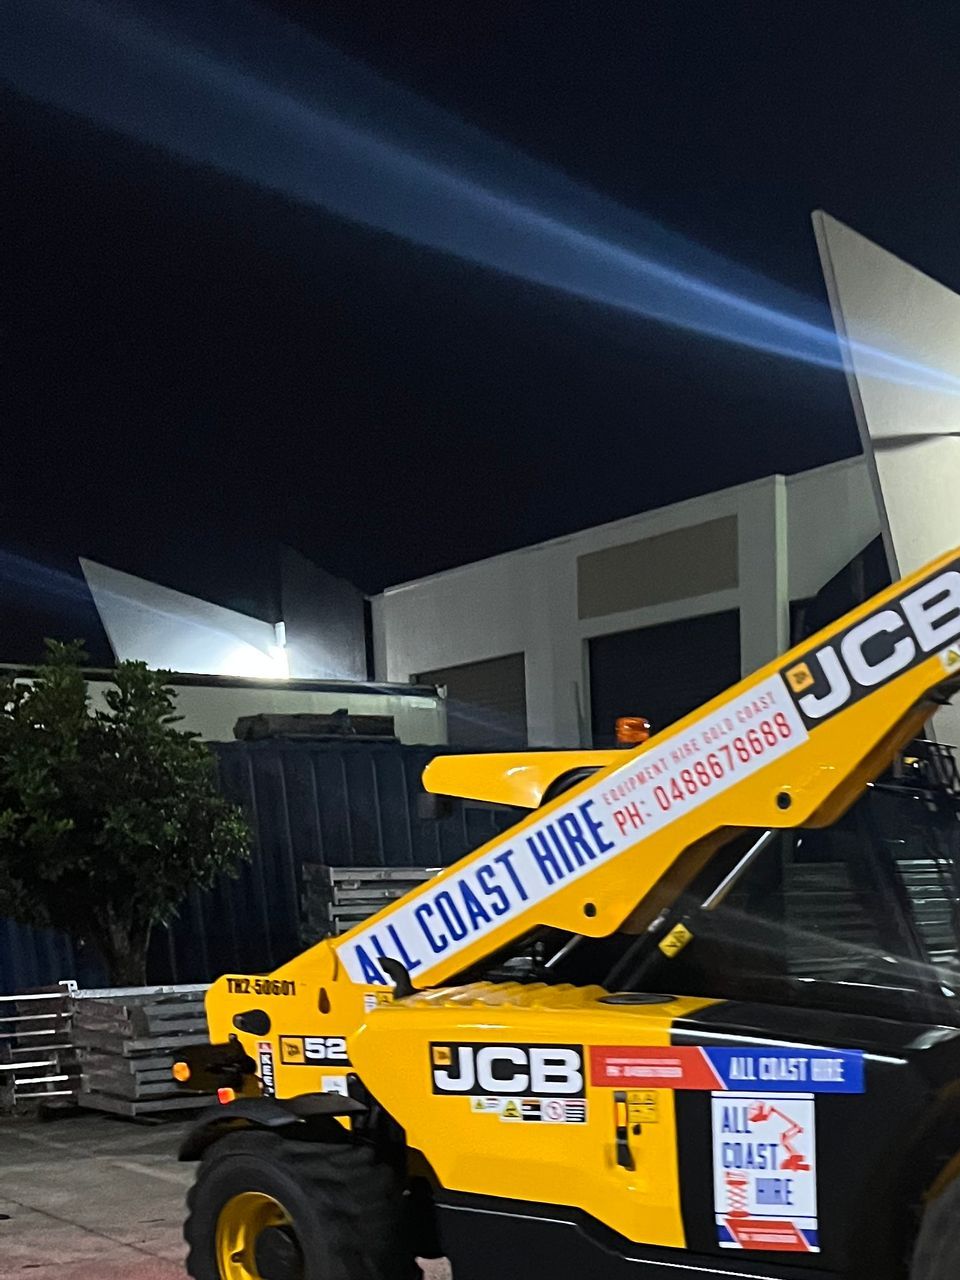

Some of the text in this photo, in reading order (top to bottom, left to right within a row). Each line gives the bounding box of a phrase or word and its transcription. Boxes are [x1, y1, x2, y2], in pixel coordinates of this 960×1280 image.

[601, 690, 777, 806] EQUIPMENT HIRE GOLD COAST
[612, 711, 792, 837] PH: 0488678688
[414, 849, 529, 954] COAST
[525, 799, 615, 886] HIRE
[433, 1046, 584, 1094] JCB
[729, 1057, 757, 1080] ALL
[759, 1057, 808, 1081] COAST
[721, 1105, 753, 1134] ALL
[722, 1142, 779, 1170] COAST
